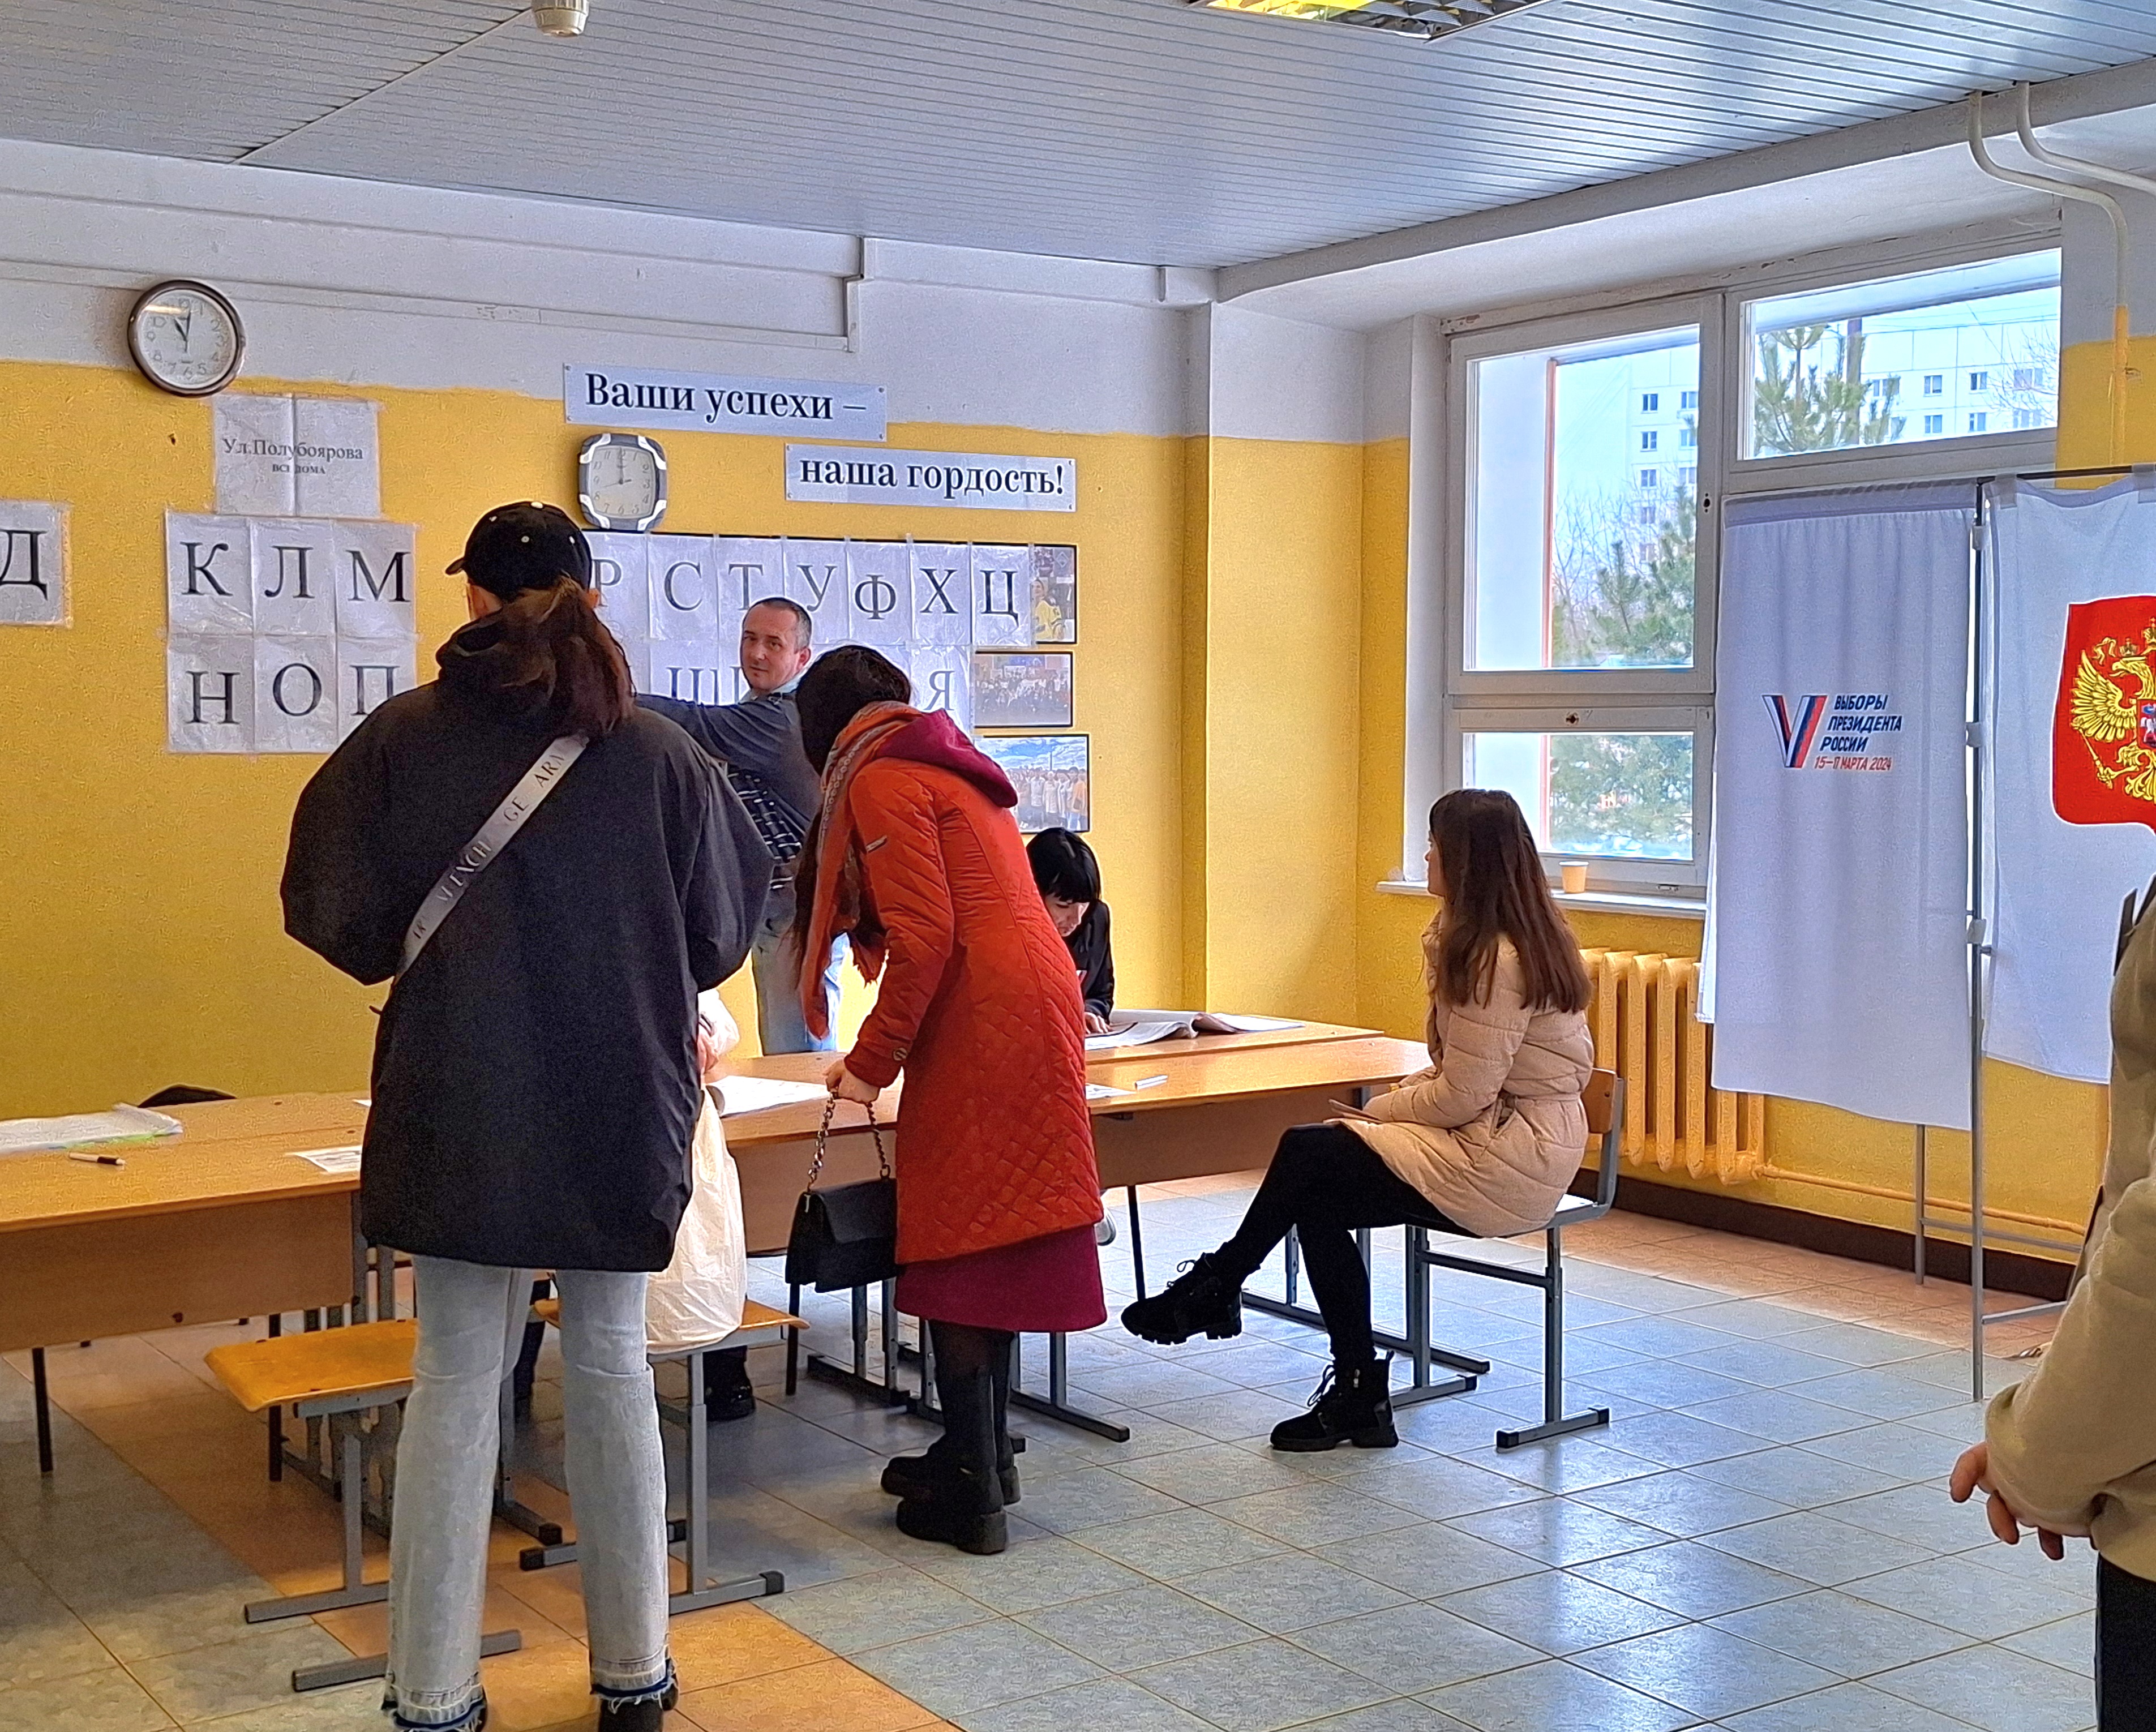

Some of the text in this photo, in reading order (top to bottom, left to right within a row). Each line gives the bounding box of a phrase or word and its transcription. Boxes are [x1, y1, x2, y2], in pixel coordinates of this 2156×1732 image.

[585, 372, 696, 410] Ваши
[705, 388, 833, 423] успехи
[643, 479, 650, 489] 3
[800, 460, 1063, 500] наша гордость!
[642, 494, 649, 504] 4
[604, 503, 610, 513] 7
[618, 504, 624, 515] 6
[632, 505, 640, 515] 5
[0, 529, 48, 601] Д
[179, 541, 411, 602] К Л М
[591, 559, 1019, 627] Р С Т У Ф Х Ц
[185, 662, 400, 725] Н О П
[927, 670, 954, 711] Я
[1834, 694, 1888, 710] ВЫБОРЫ
[1827, 715, 1902, 734] ПРЕЗИДЕНТА
[1820, 736, 1868, 752] РОССИИ
[1841, 757, 1867, 770] МАРТА
[1868, 757, 1892, 771] 2024
